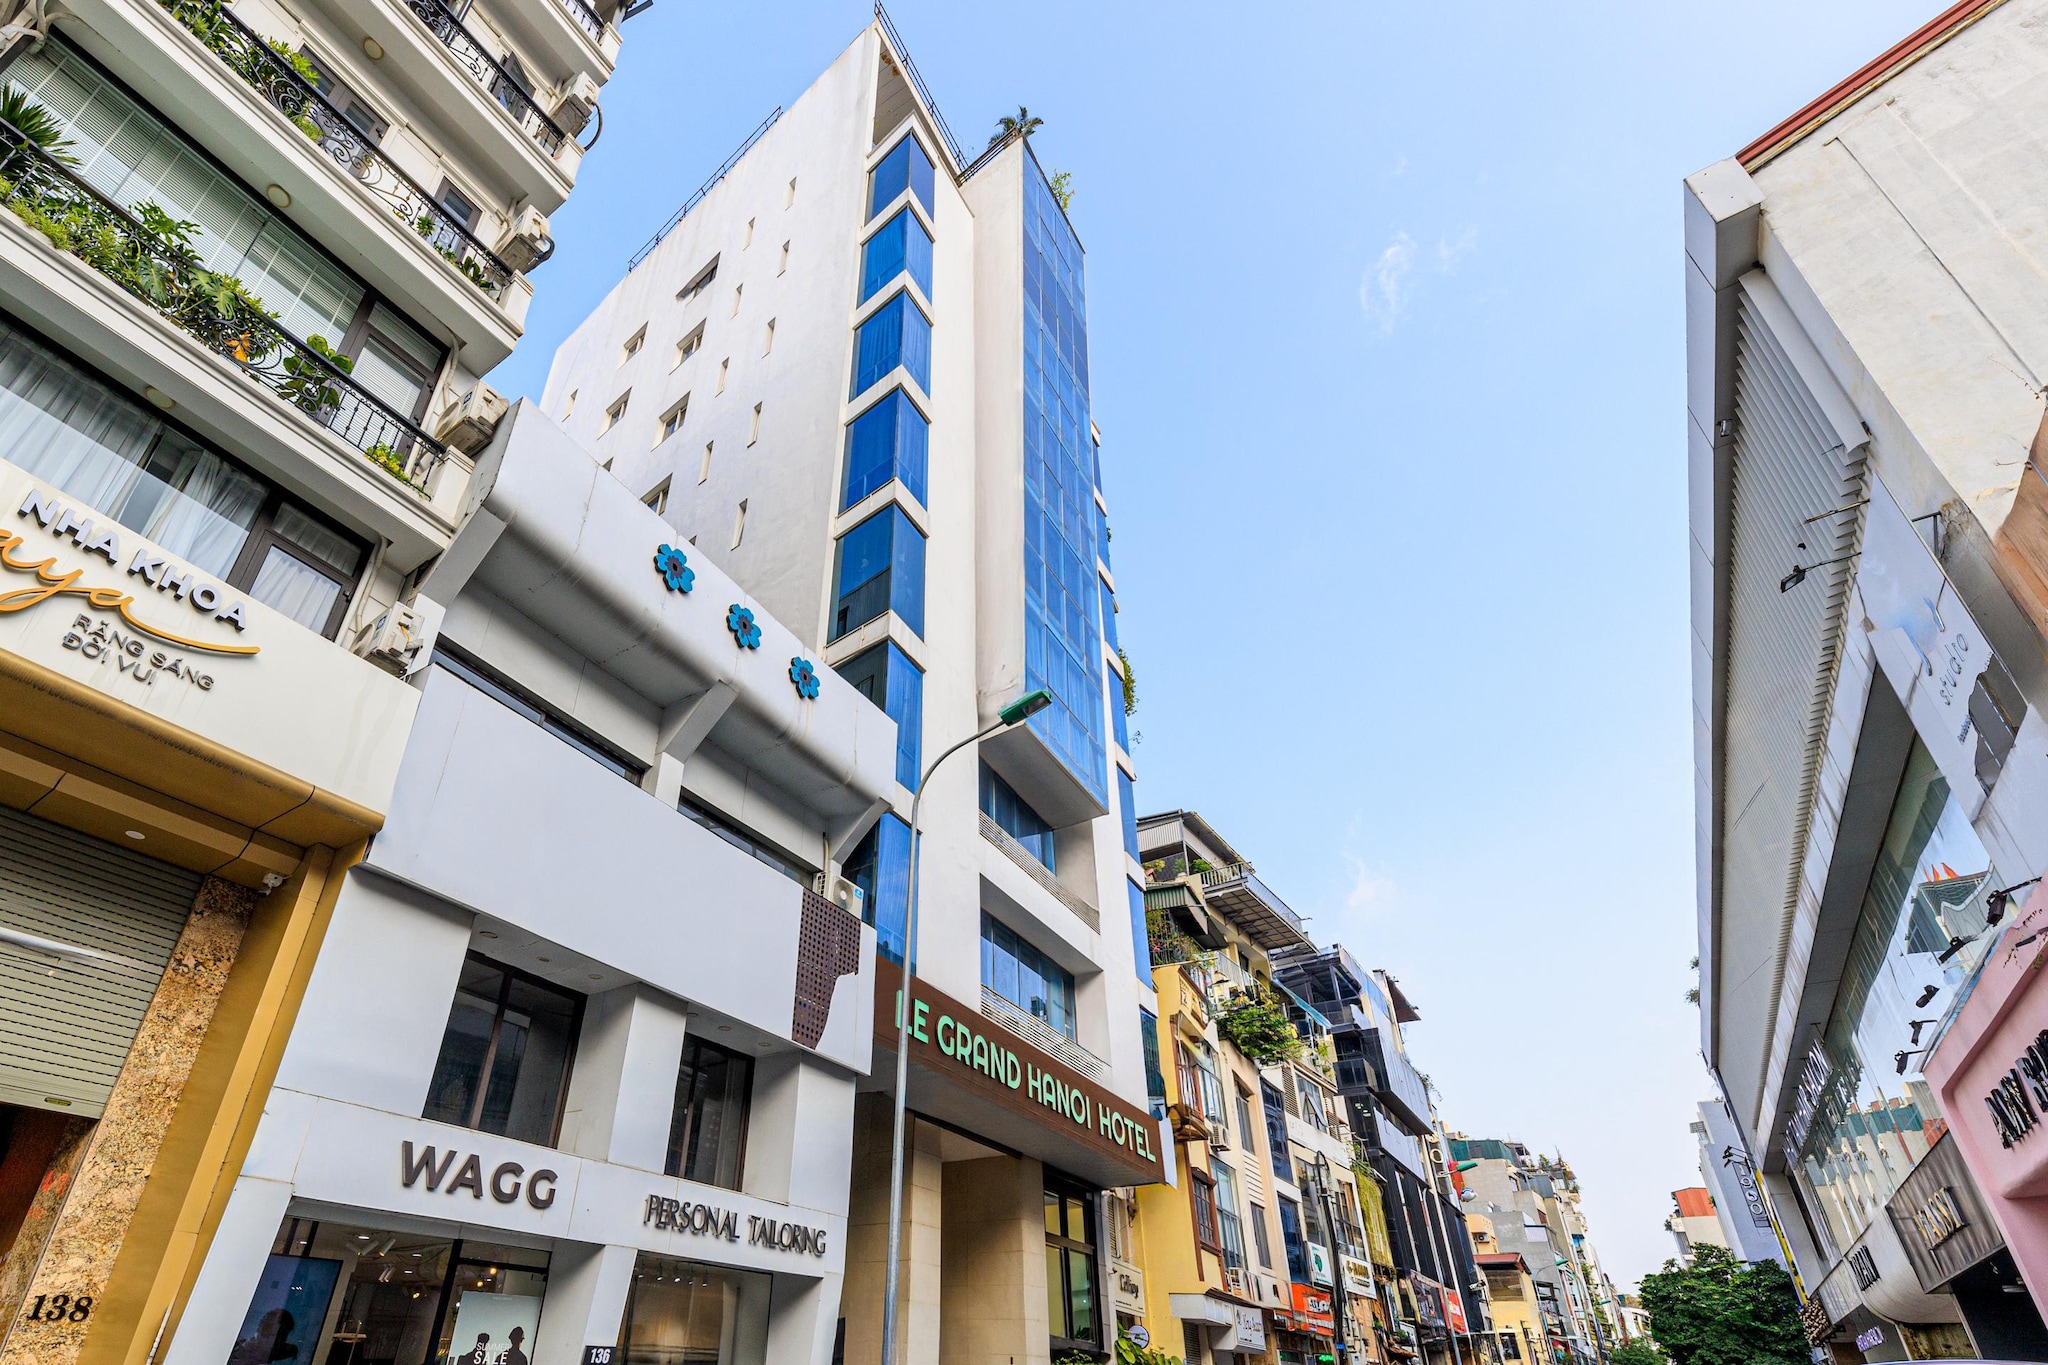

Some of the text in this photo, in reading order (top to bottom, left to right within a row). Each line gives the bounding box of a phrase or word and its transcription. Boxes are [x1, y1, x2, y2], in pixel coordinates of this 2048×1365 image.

[17, 489, 248, 632] NHA KHOA
[62, 631, 157, 685] ĐỜI VUI
[72, 613, 214, 690] RĂNG SÁNG
[1940, 633, 1968, 706] studio
[895, 989, 1156, 1163] LE GRAND HANOI HOTEL
[1801, 1039, 1833, 1108] SALON
[401, 1140, 558, 1209] WAGG
[644, 1194, 827, 1257] PERSONAL TAILORING
[26, 1293, 93, 1322] 138
[473, 1351, 509, 1365] SALE
[476, 1341, 509, 1351] SUMMER
[590, 1347, 611, 1364] 136
